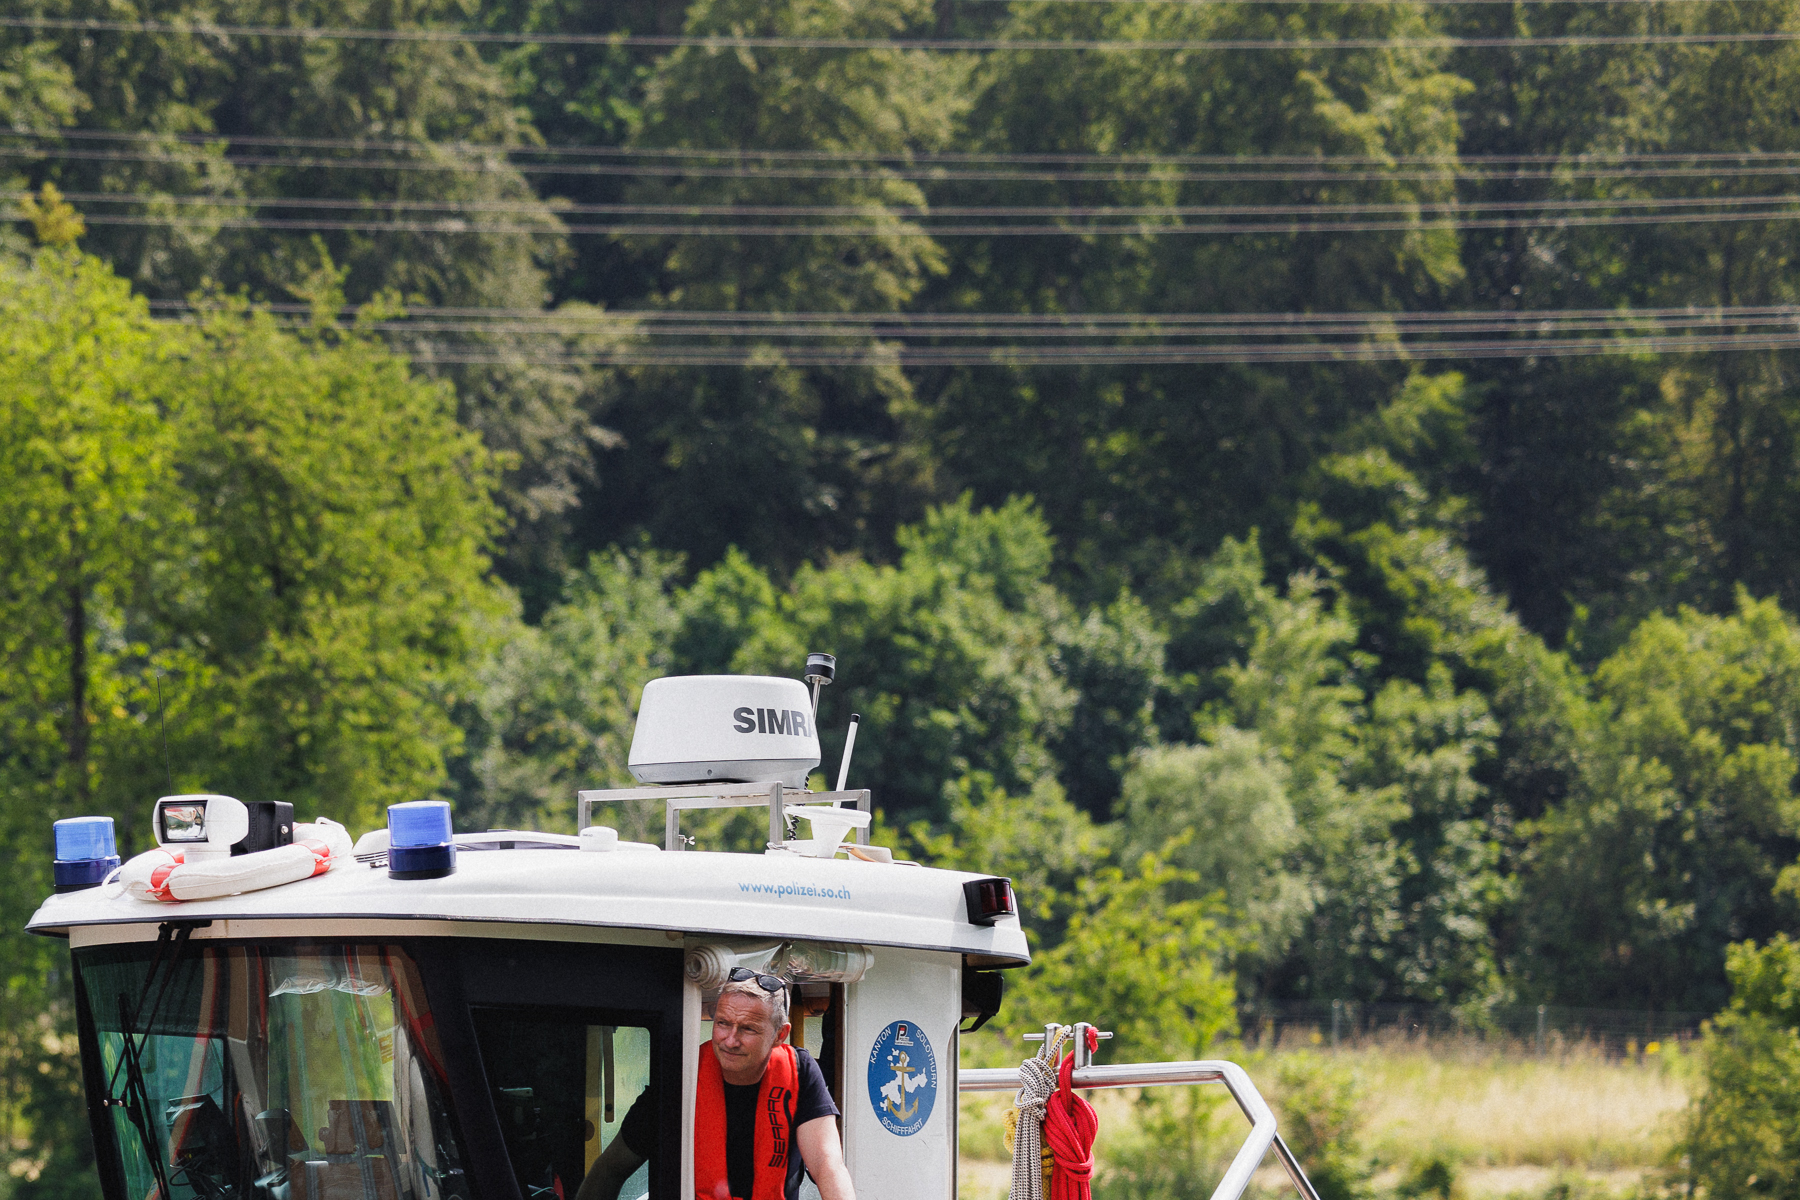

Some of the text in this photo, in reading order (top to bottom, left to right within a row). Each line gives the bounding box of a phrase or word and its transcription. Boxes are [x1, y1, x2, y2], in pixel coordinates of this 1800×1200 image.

[738, 881, 851, 900] www.polizei.so.ch
[869, 1027, 937, 1088] KANTON SOLOTHURN
[768, 1086, 785, 1168] SEAPRO
[881, 1116, 923, 1135] SCHIFFFAHRT
